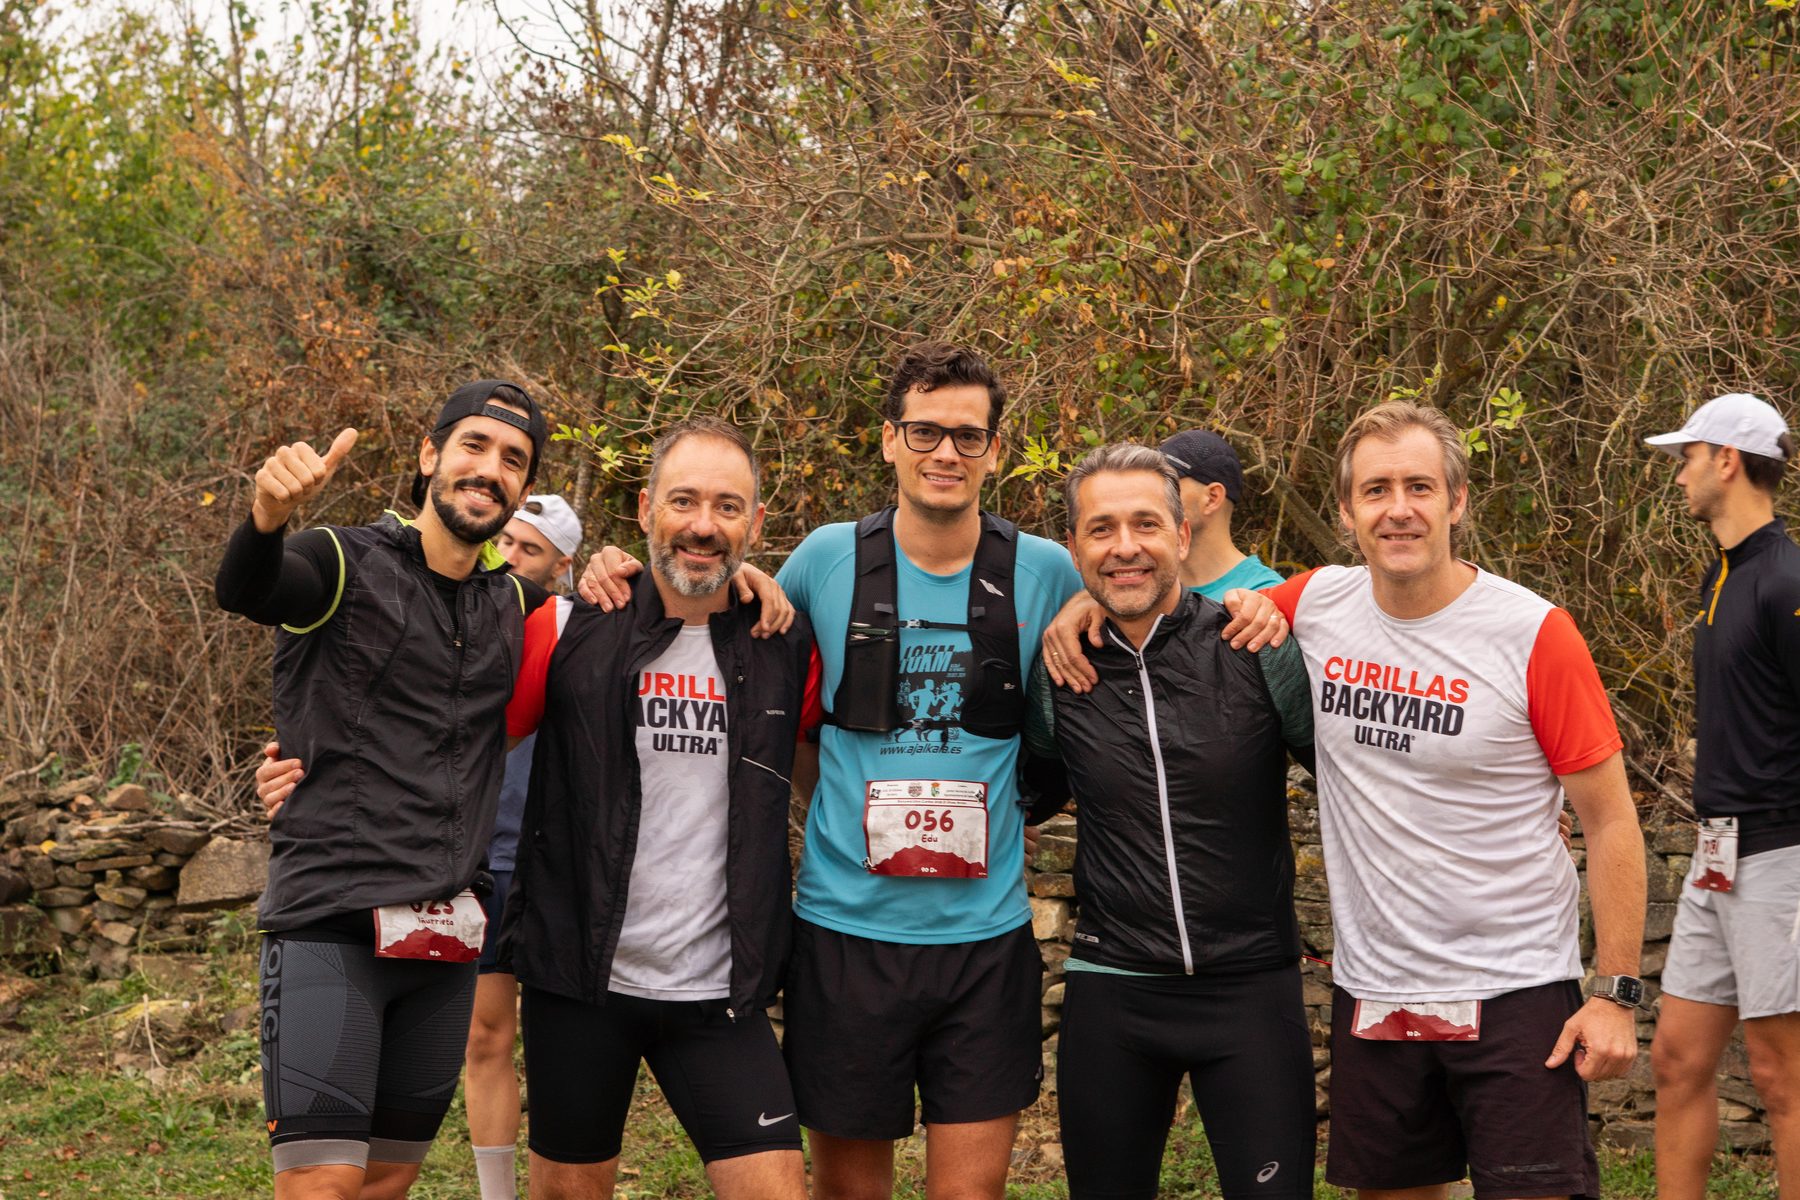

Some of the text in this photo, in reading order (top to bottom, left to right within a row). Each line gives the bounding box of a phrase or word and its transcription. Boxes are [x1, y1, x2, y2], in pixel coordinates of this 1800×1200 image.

[1324, 656, 1470, 704] CURILLAS
[1320, 680, 1465, 737] BACKYARD
[904, 809, 954, 832] 056
[921, 834, 938, 843] Edu
